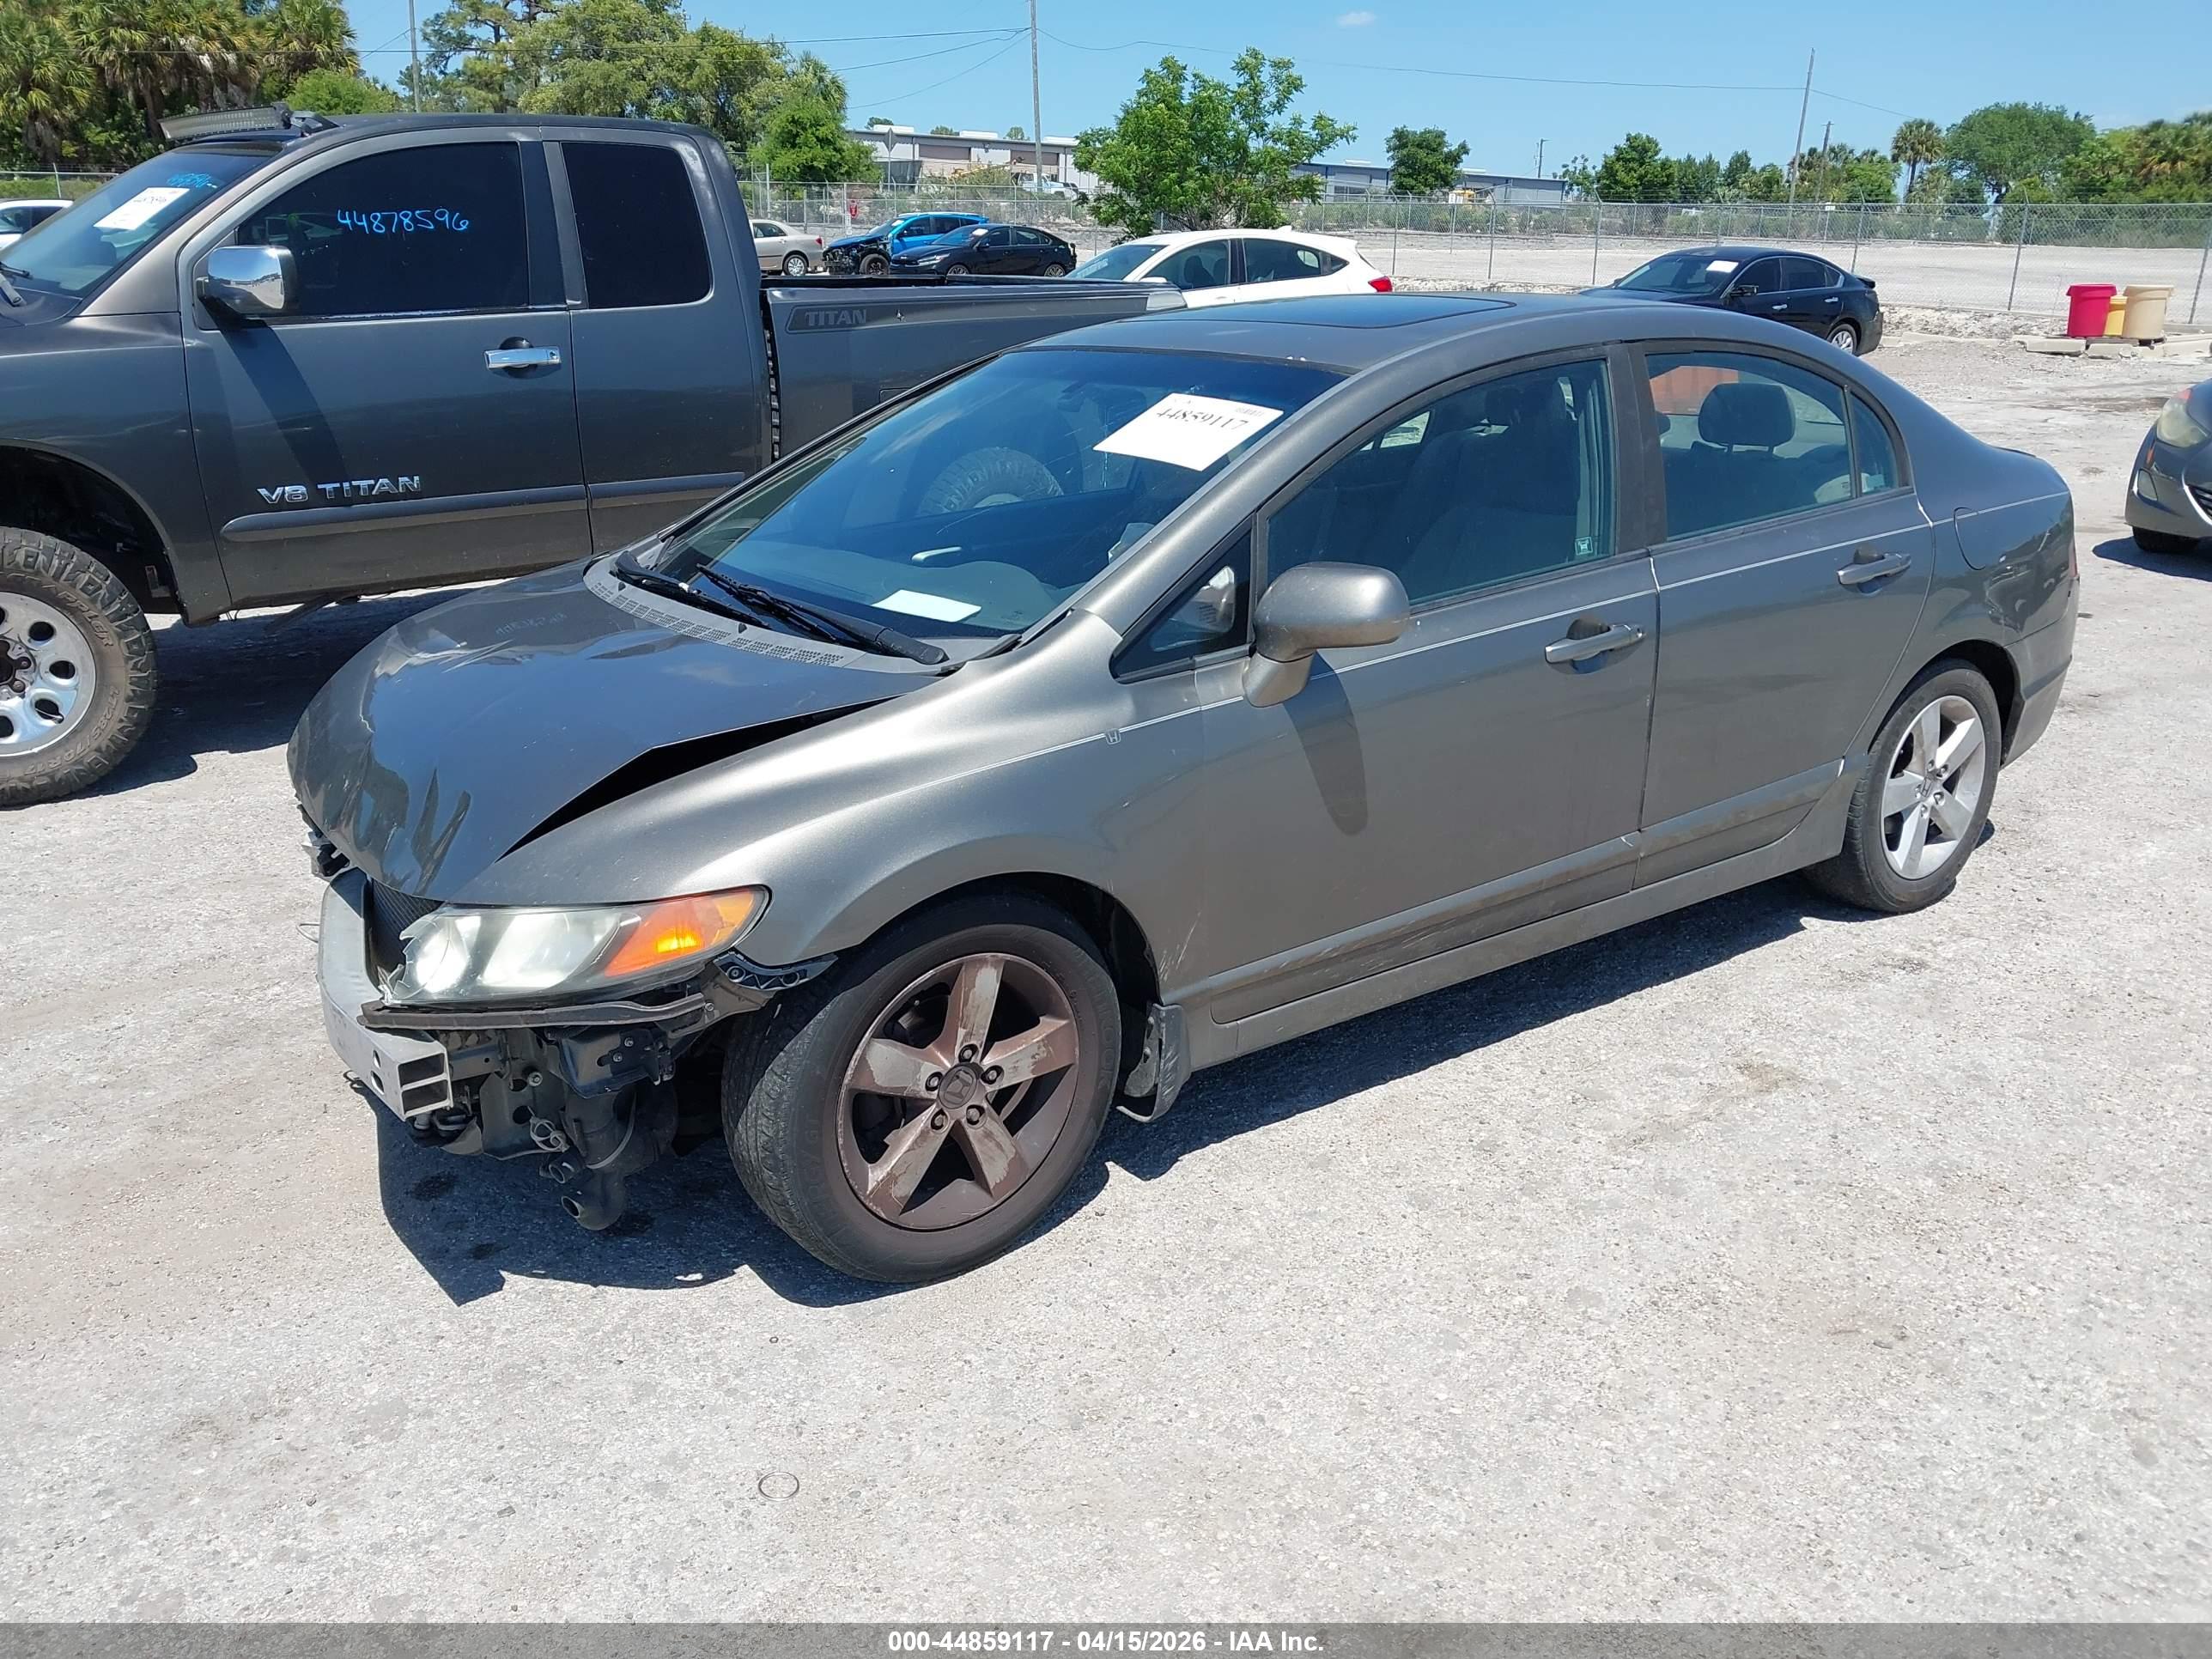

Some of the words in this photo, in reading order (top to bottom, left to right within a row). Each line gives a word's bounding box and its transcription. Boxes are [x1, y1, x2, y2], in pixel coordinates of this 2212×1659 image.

[337, 208, 469, 234] 44878596
[805, 309, 866, 325] TITAN
[257, 485, 308, 504] V8
[317, 476, 421, 499] TITAN
